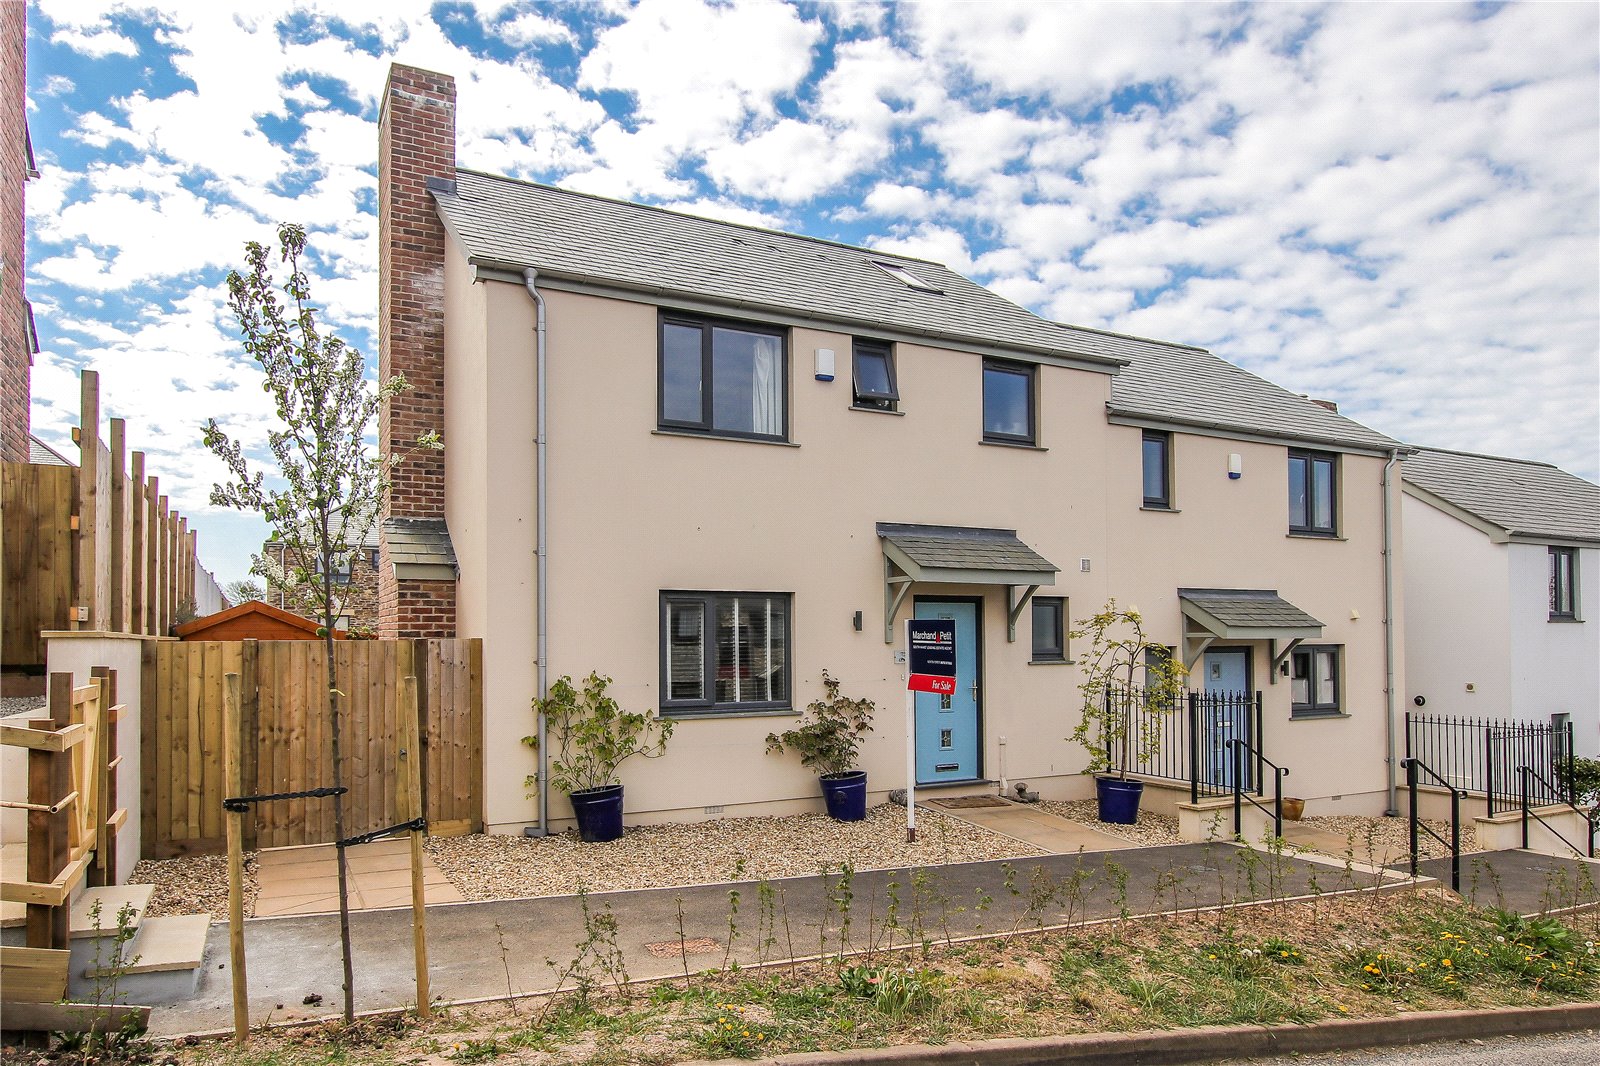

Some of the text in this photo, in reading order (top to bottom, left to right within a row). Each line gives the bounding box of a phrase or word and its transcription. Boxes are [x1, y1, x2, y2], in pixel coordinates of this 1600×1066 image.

[912, 631, 952, 640] Marchand Petit
[932, 680, 952, 690] For Sale
